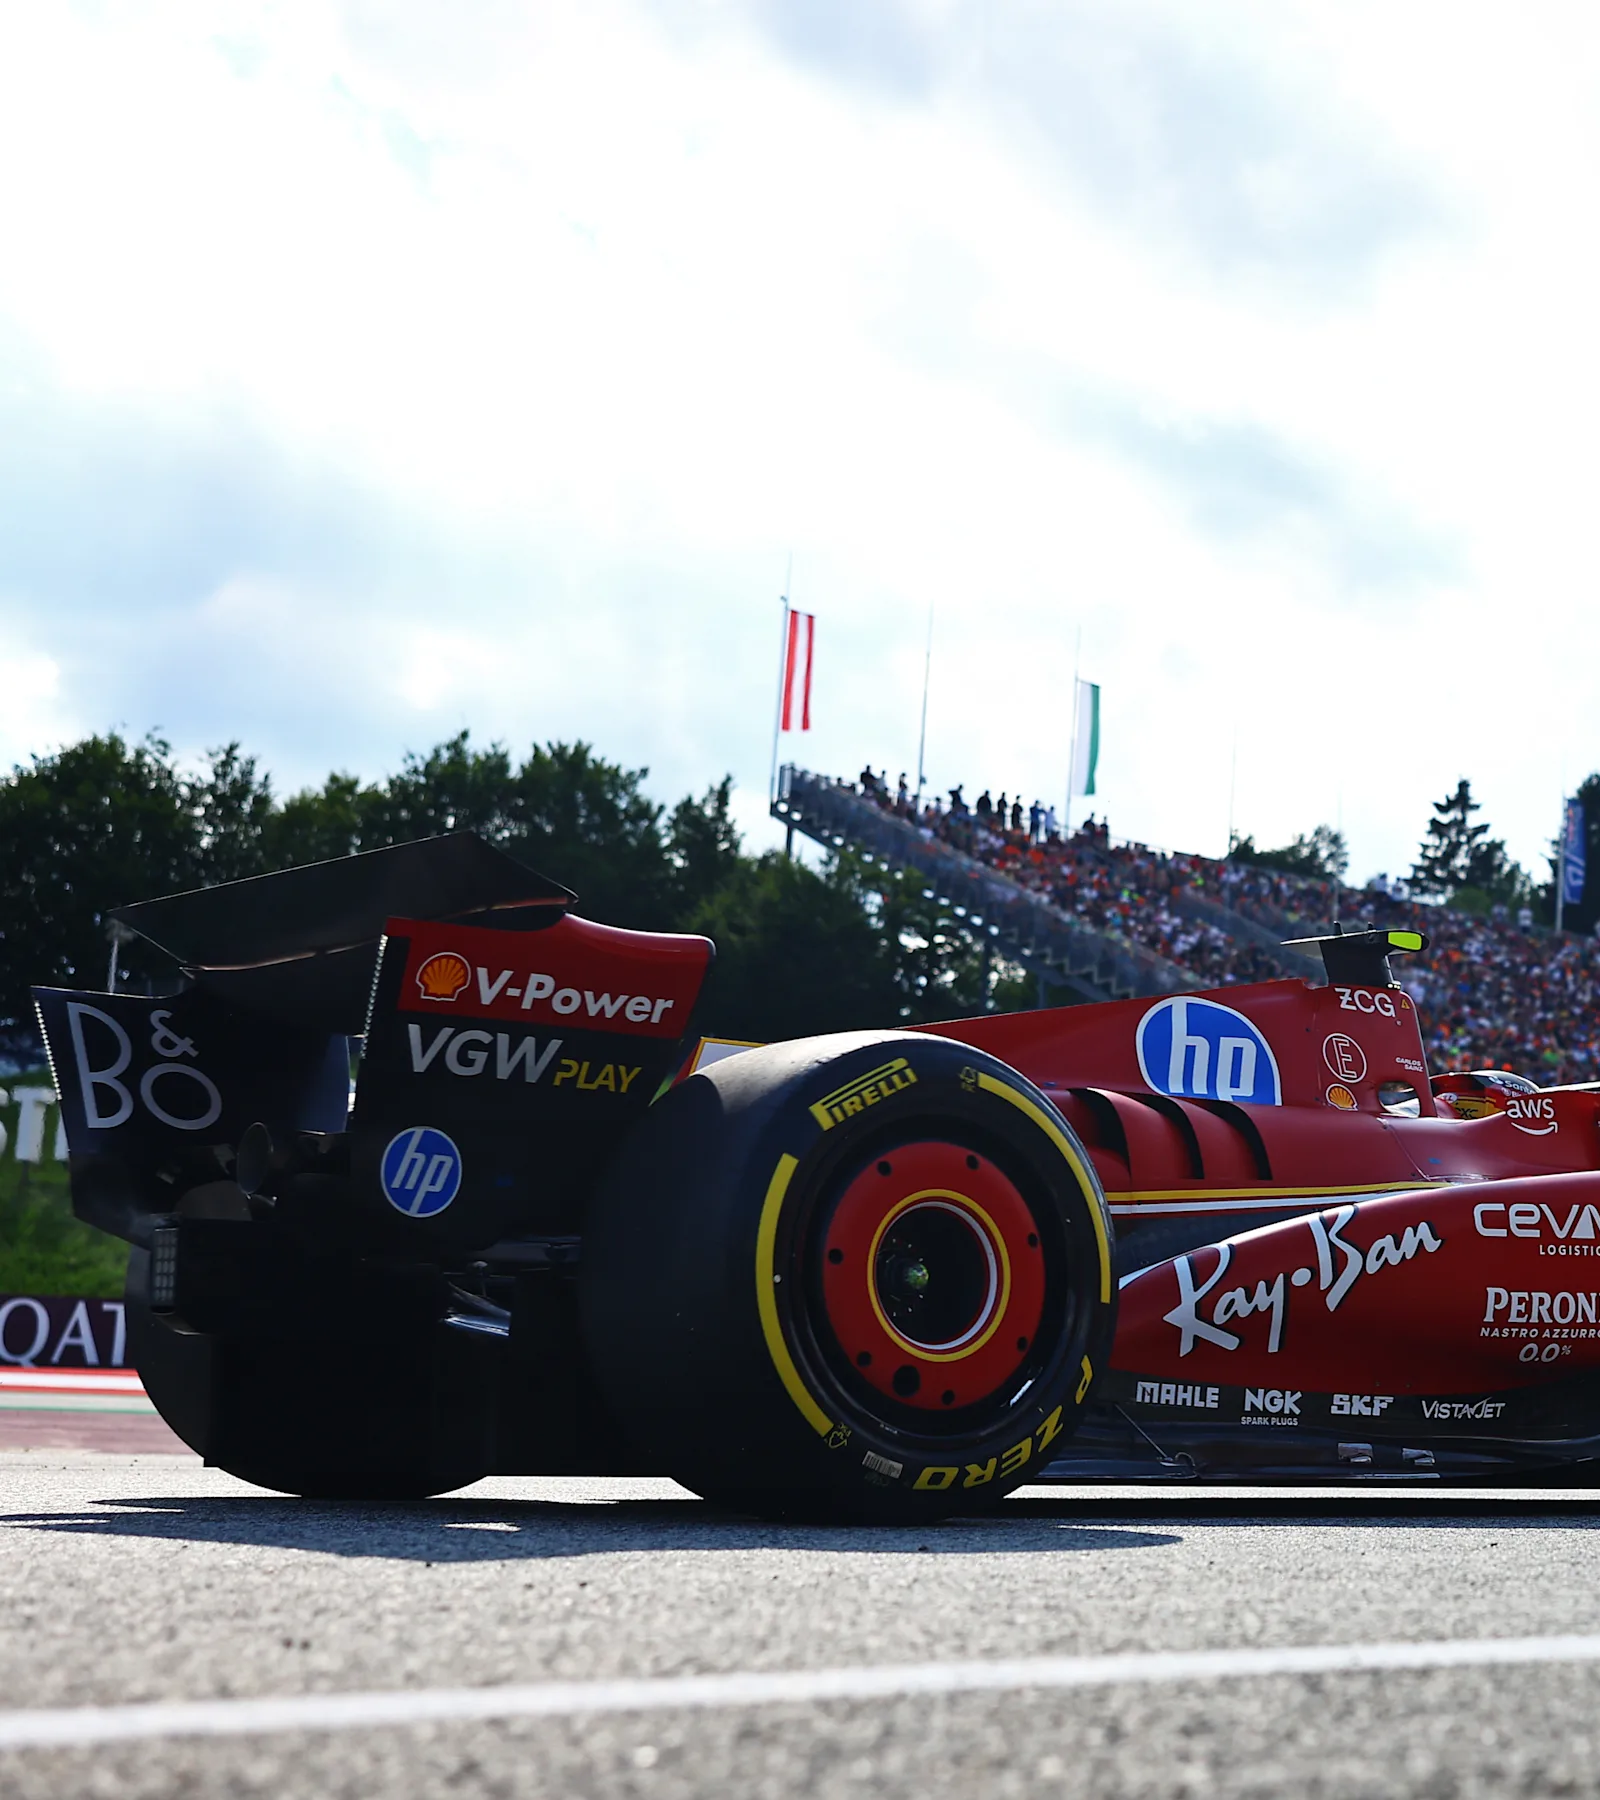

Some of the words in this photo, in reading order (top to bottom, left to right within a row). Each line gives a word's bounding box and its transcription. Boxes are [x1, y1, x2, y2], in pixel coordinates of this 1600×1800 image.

[476, 967, 674, 1024] V-Power
[408, 1023, 563, 1083] VGW
[553, 1059, 642, 1093] PLAY
[1167, 998, 1257, 1102] hp
[1395, 1057, 1421, 1066] CARLOS
[1404, 1063, 1424, 1072] SAINZ
[808, 1058, 918, 1132] PIRELLI
[1507, 1099, 1554, 1118] aws
[390, 1128, 454, 1215] hp
[1480, 1327, 1539, 1338] NASTRO
[1518, 1343, 1572, 1363] 0.0%
[1136, 1381, 1219, 1409] MAHLE
[1245, 1388, 1302, 1415] NGK
[1330, 1394, 1394, 1417] SKF
[1241, 1416, 1268, 1426] SPARK
[1270, 1416, 1299, 1427] PLUGS
[912, 1405, 1064, 1490] ZERO
